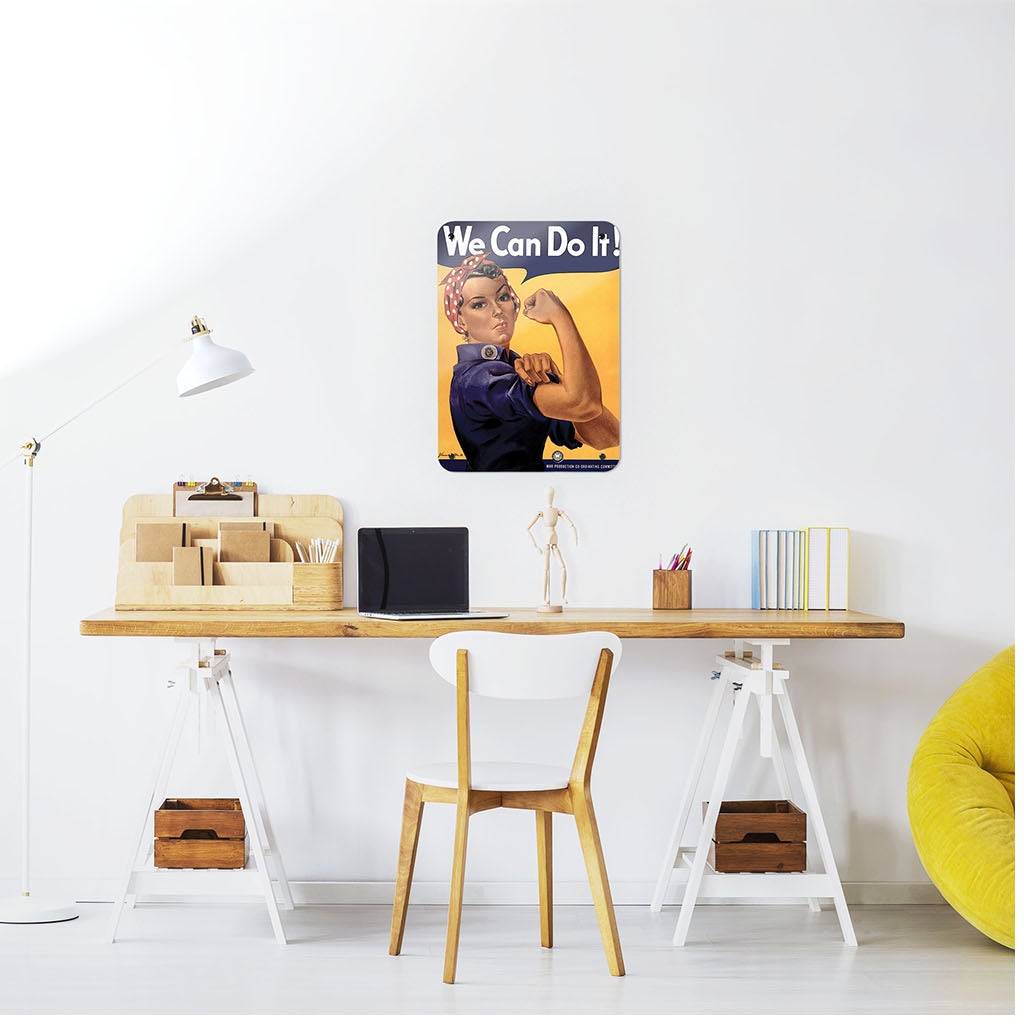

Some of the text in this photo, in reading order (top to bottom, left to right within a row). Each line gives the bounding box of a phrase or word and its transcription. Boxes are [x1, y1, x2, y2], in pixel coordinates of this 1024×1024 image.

[443, 225, 620, 257] We Can Do It!
